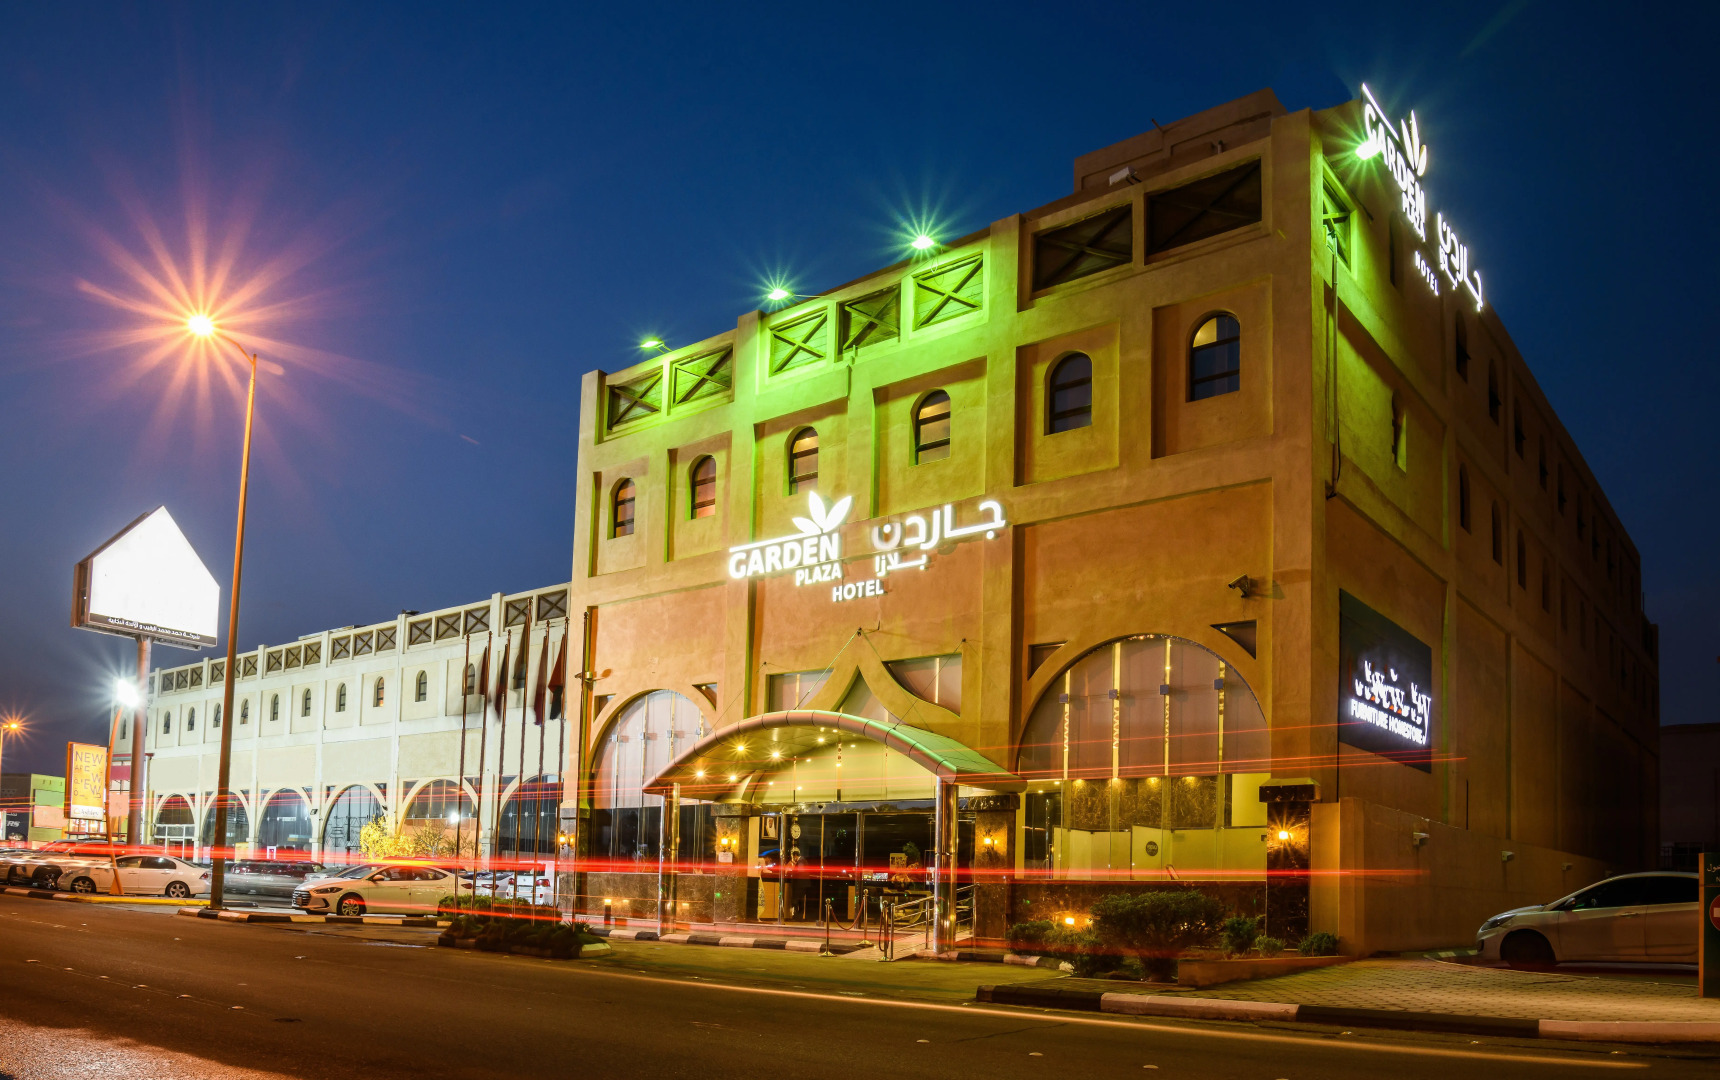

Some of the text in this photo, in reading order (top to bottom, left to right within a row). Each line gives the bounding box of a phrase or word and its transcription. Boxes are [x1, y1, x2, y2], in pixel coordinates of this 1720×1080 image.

[1364, 103, 1425, 224] GARDEN
[1415, 250, 1439, 296] HOTEL
[872, 500, 1006, 550] جاردن
[728, 532, 840, 579] GARDEN
[795, 561, 842, 587] PLAZA
[874, 552, 927, 577] بلازا
[832, 579, 884, 602] HOTEL
[1351, 698, 1423, 745] FURNITURE HOMESTORE
[75, 751, 103, 764] NEW
